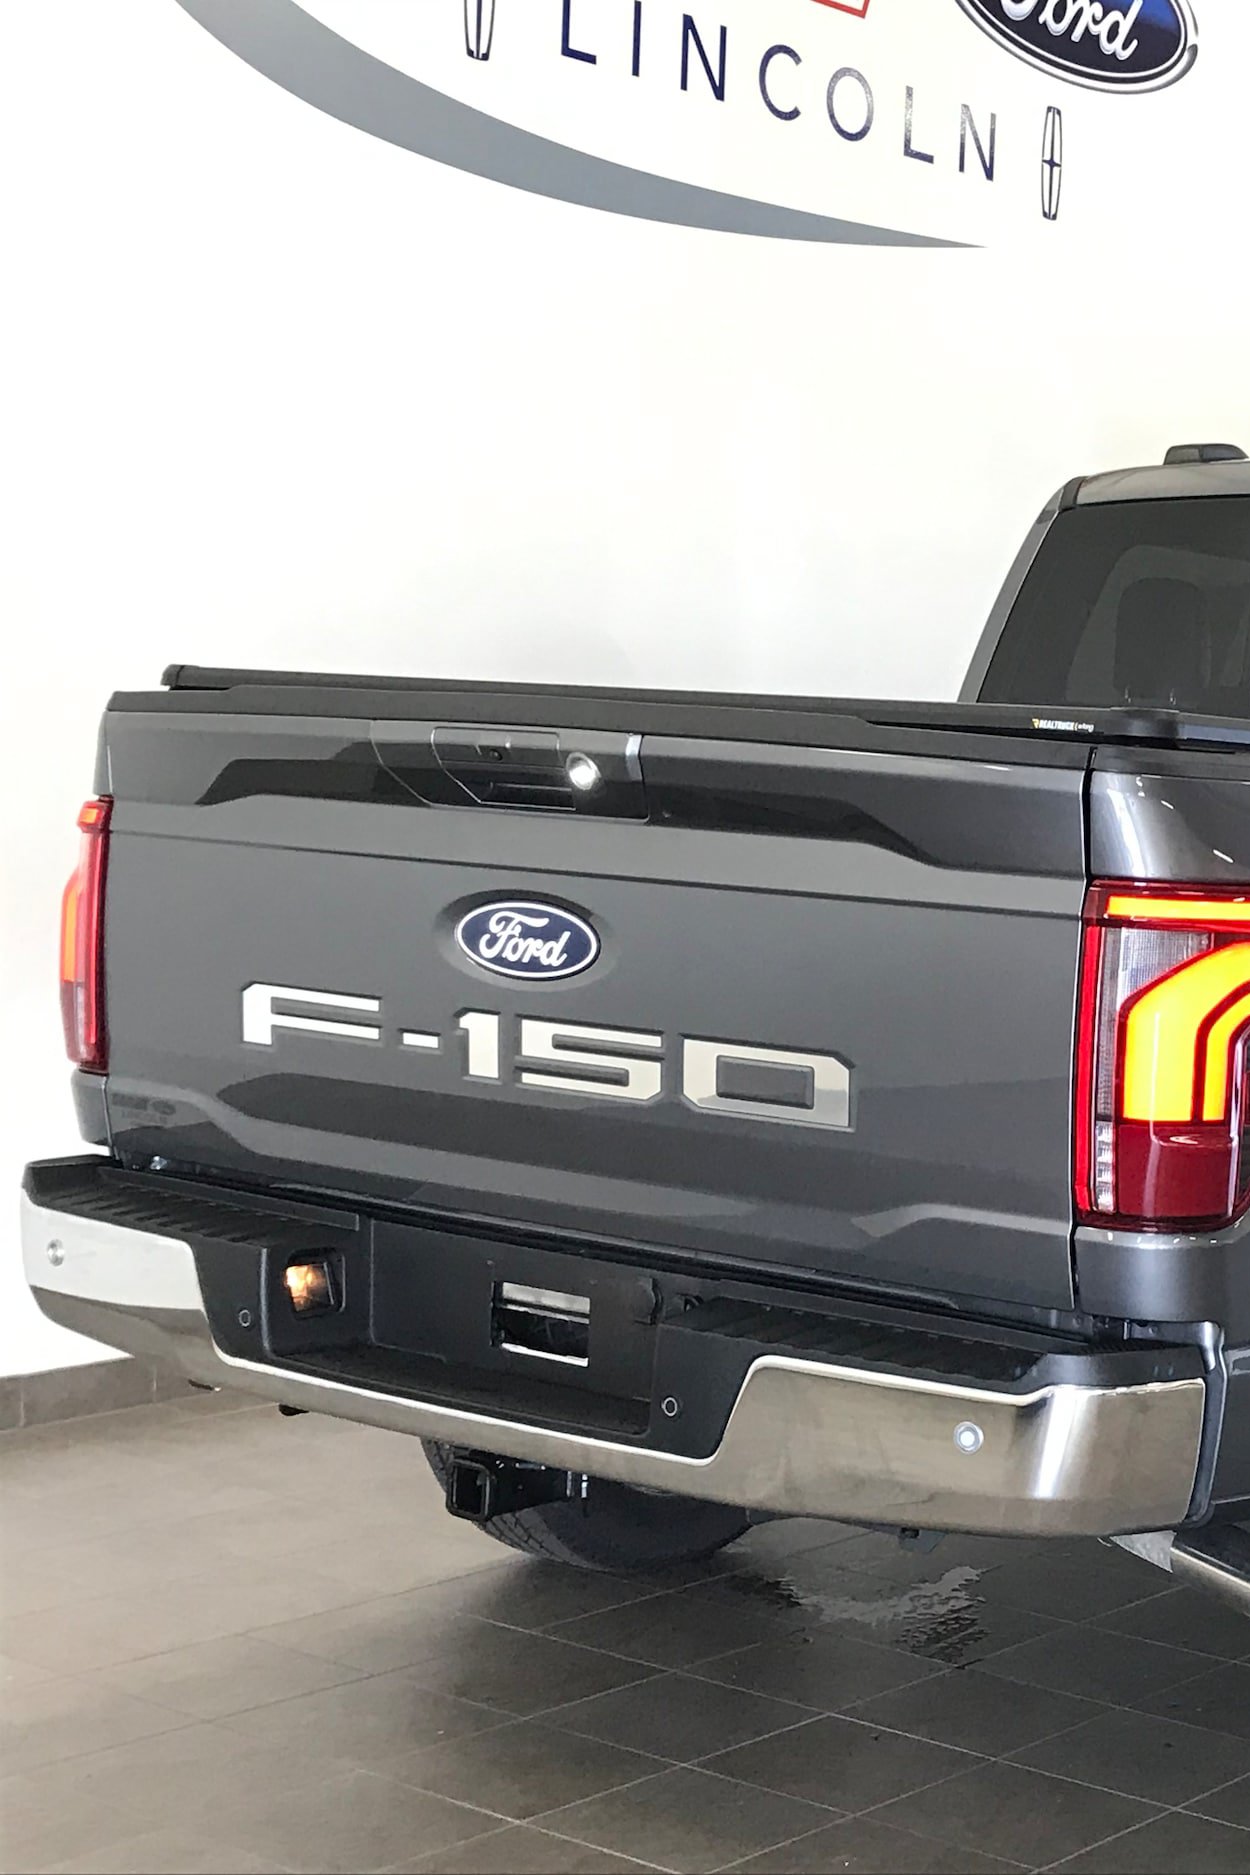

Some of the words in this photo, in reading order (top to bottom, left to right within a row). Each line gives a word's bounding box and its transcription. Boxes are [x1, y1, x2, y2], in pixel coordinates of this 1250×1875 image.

[561, 0, 996, 181] LINCOLN
[480, 910, 567, 969] Ford
[241, 982, 852, 1128] F-150
